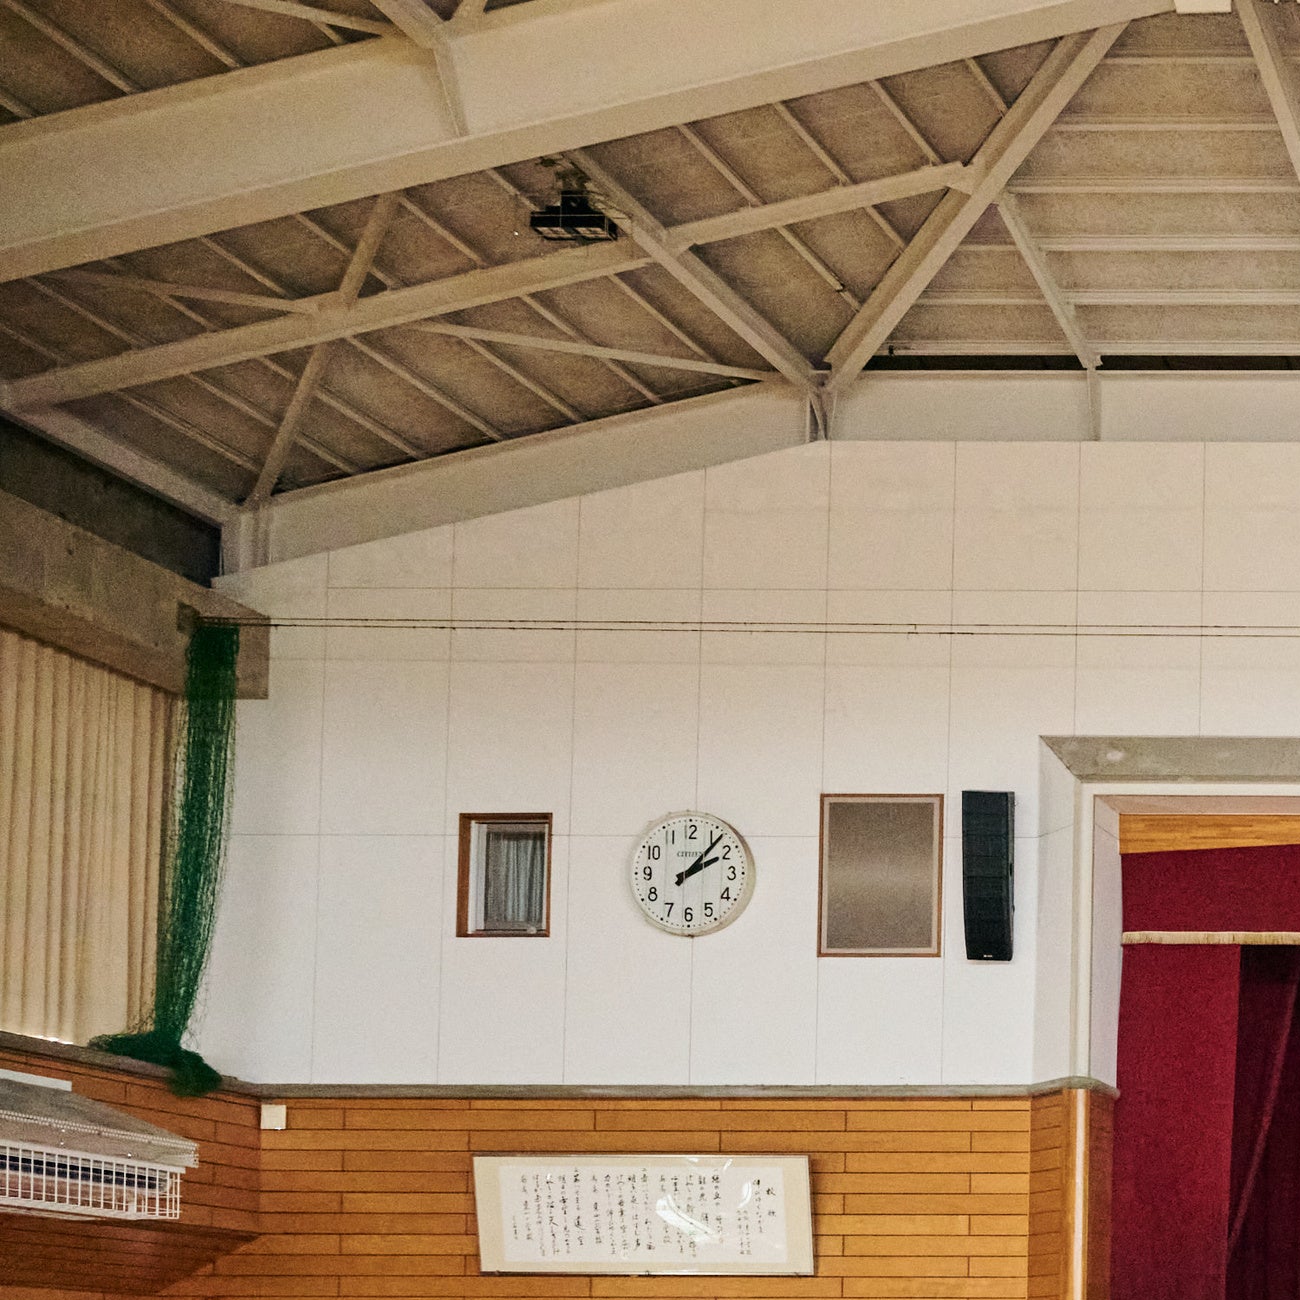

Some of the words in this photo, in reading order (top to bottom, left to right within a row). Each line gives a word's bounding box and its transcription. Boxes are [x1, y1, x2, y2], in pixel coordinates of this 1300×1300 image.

[684, 824, 698, 840] 12
[647, 845, 661, 860] 10
[721, 844, 731, 860] 2
[643, 866, 652, 881] 9
[726, 865, 737, 881] 3
[647, 886, 658, 902] 8
[720, 886, 731, 902] 4
[664, 902, 674, 918] 7
[683, 906, 693, 922] 6
[703, 902, 714, 918] 5
